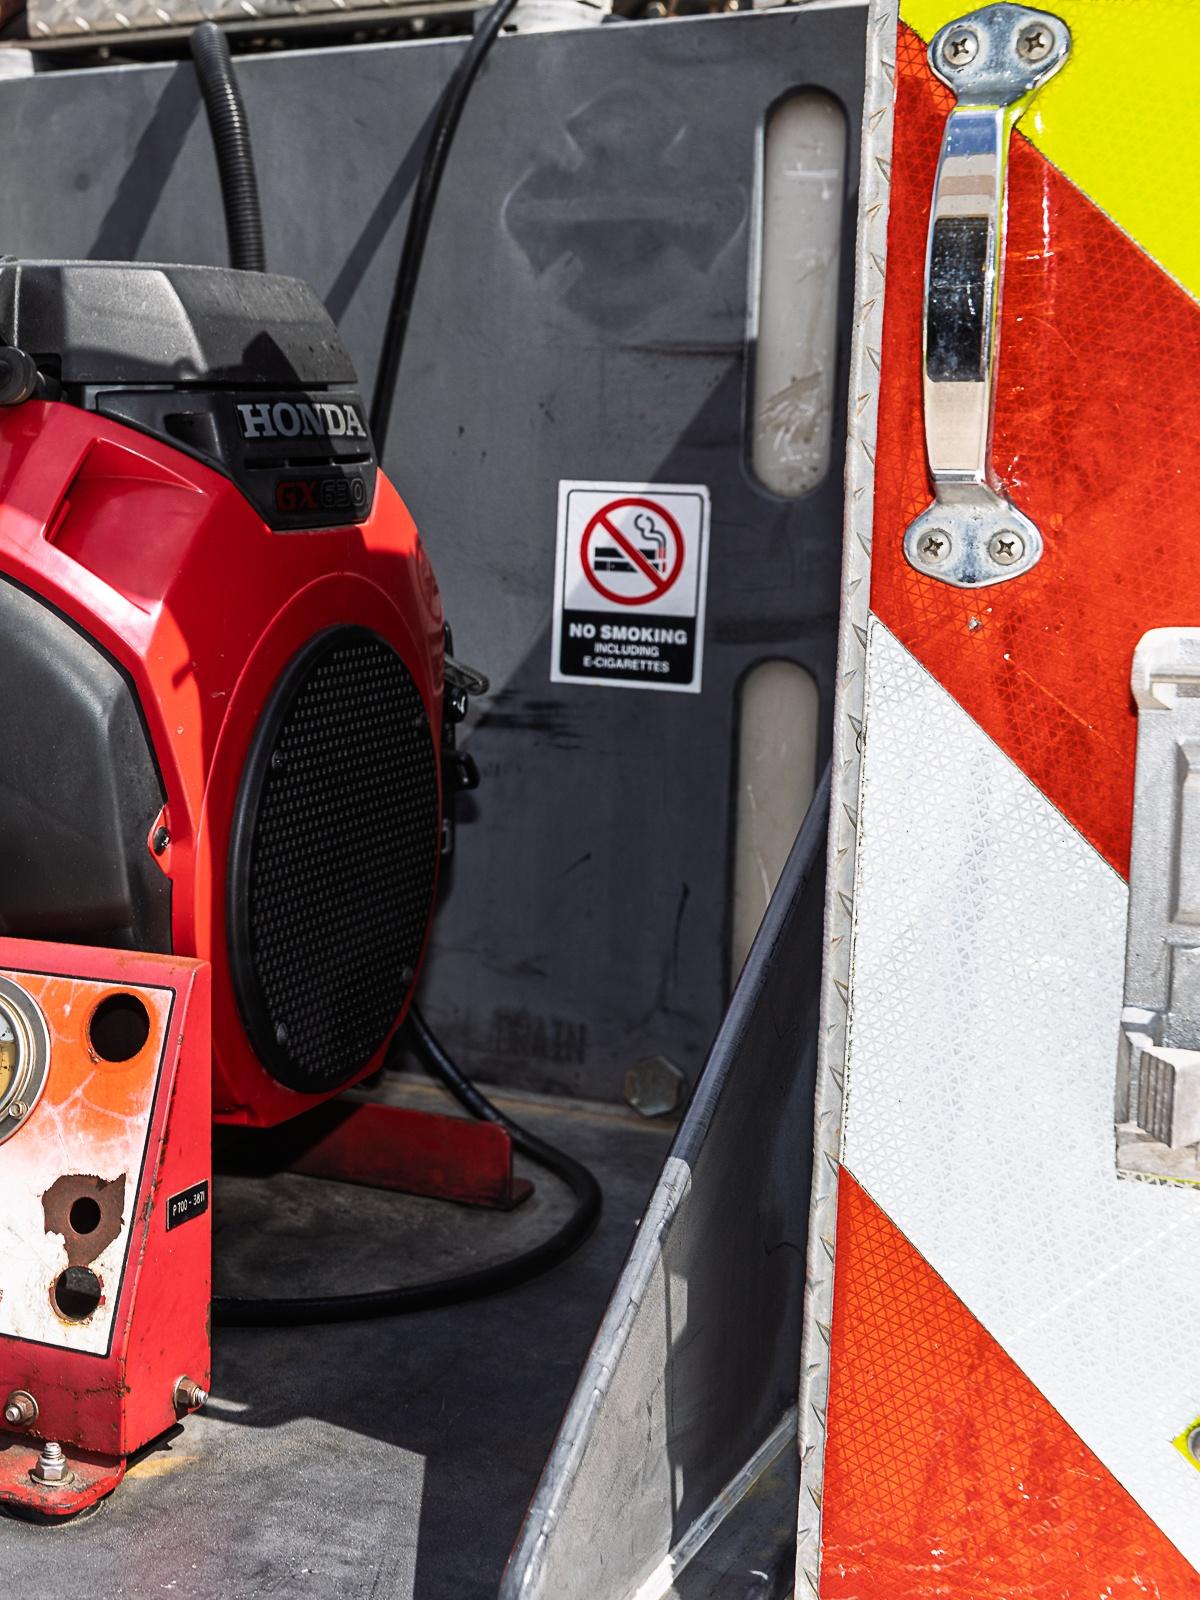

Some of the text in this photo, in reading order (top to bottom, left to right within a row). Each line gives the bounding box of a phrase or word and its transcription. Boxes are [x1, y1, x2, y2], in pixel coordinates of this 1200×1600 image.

[237, 402, 367, 438] HONDA
[275, 478, 367, 512] GX630
[569, 623, 688, 645] NO SMOKING
[594, 642, 660, 657] INCLUDING
[582, 655, 670, 673] E-CIGARETTES
